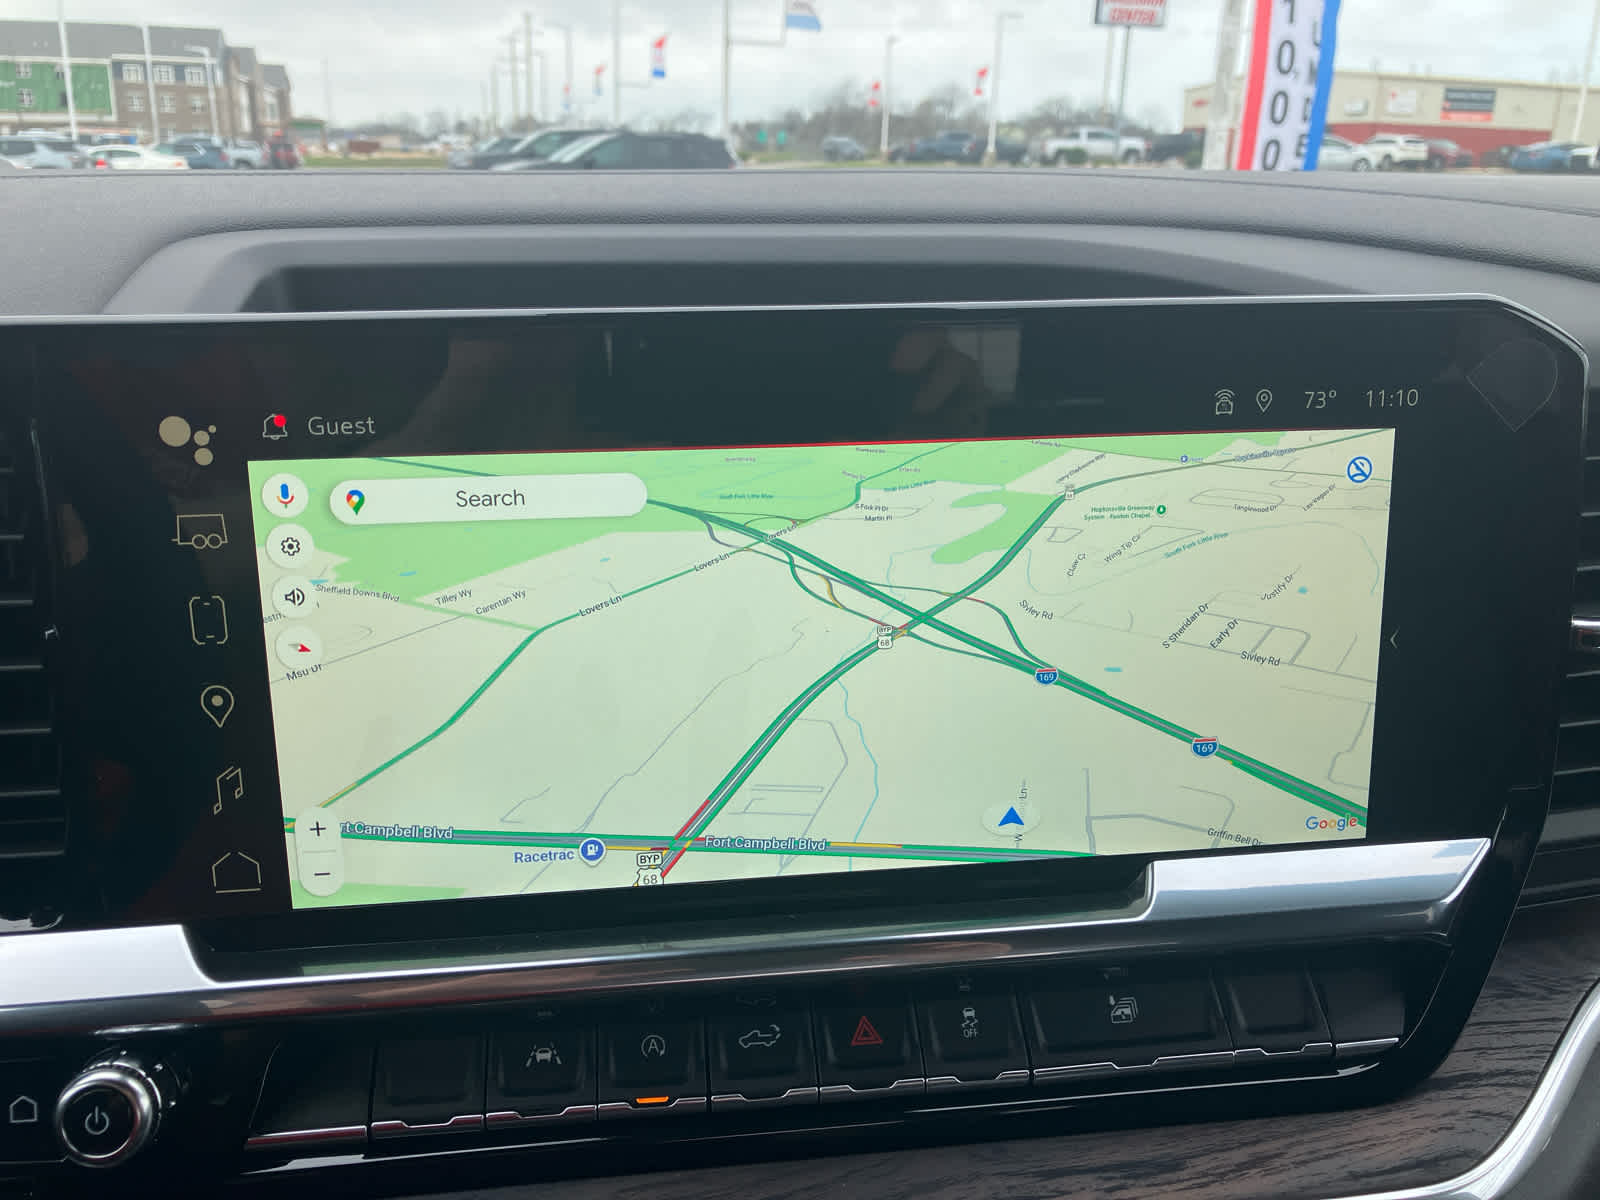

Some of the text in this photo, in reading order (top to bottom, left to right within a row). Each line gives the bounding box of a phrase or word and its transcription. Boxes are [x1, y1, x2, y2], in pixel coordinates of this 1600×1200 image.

[1304, 389, 1337, 409] 73°
[1366, 388, 1420, 408] 11:10
[306, 416, 376, 435] Guest
[455, 489, 526, 508] Search
[694, 558, 719, 572] Lovers
[315, 584, 400, 603] Sheffield Downs Blvd
[512, 588, 527, 601] Wy
[1260, 573, 1294, 602] Justify Dr
[435, 588, 473, 606] Tilley Wy
[578, 594, 623, 617] Lovers Ln
[1041, 610, 1054, 620] Rd
[1161, 602, 1210, 650] S Sheridan Dr
[1209, 617, 1240, 650] Early Dr
[880, 639, 890, 647] 68
[1240, 650, 1281, 667] Sivley Rd
[286, 668, 309, 682] Msu
[1038, 672, 1055, 682] 169
[1196, 742, 1214, 754] 169
[352, 820, 419, 841] Campbell
[421, 825, 454, 841] Blvd
[1305, 812, 1358, 832] Google
[704, 834, 827, 853] Fort Campbell Blvd
[1207, 827, 1233, 842] Griffin
[1234, 833, 1251, 846] Bell
[513, 848, 575, 864] Racetrac
[639, 853, 660, 864] BYP
[643, 873, 658, 885] 68
[963, 1029, 979, 1038] OFF
